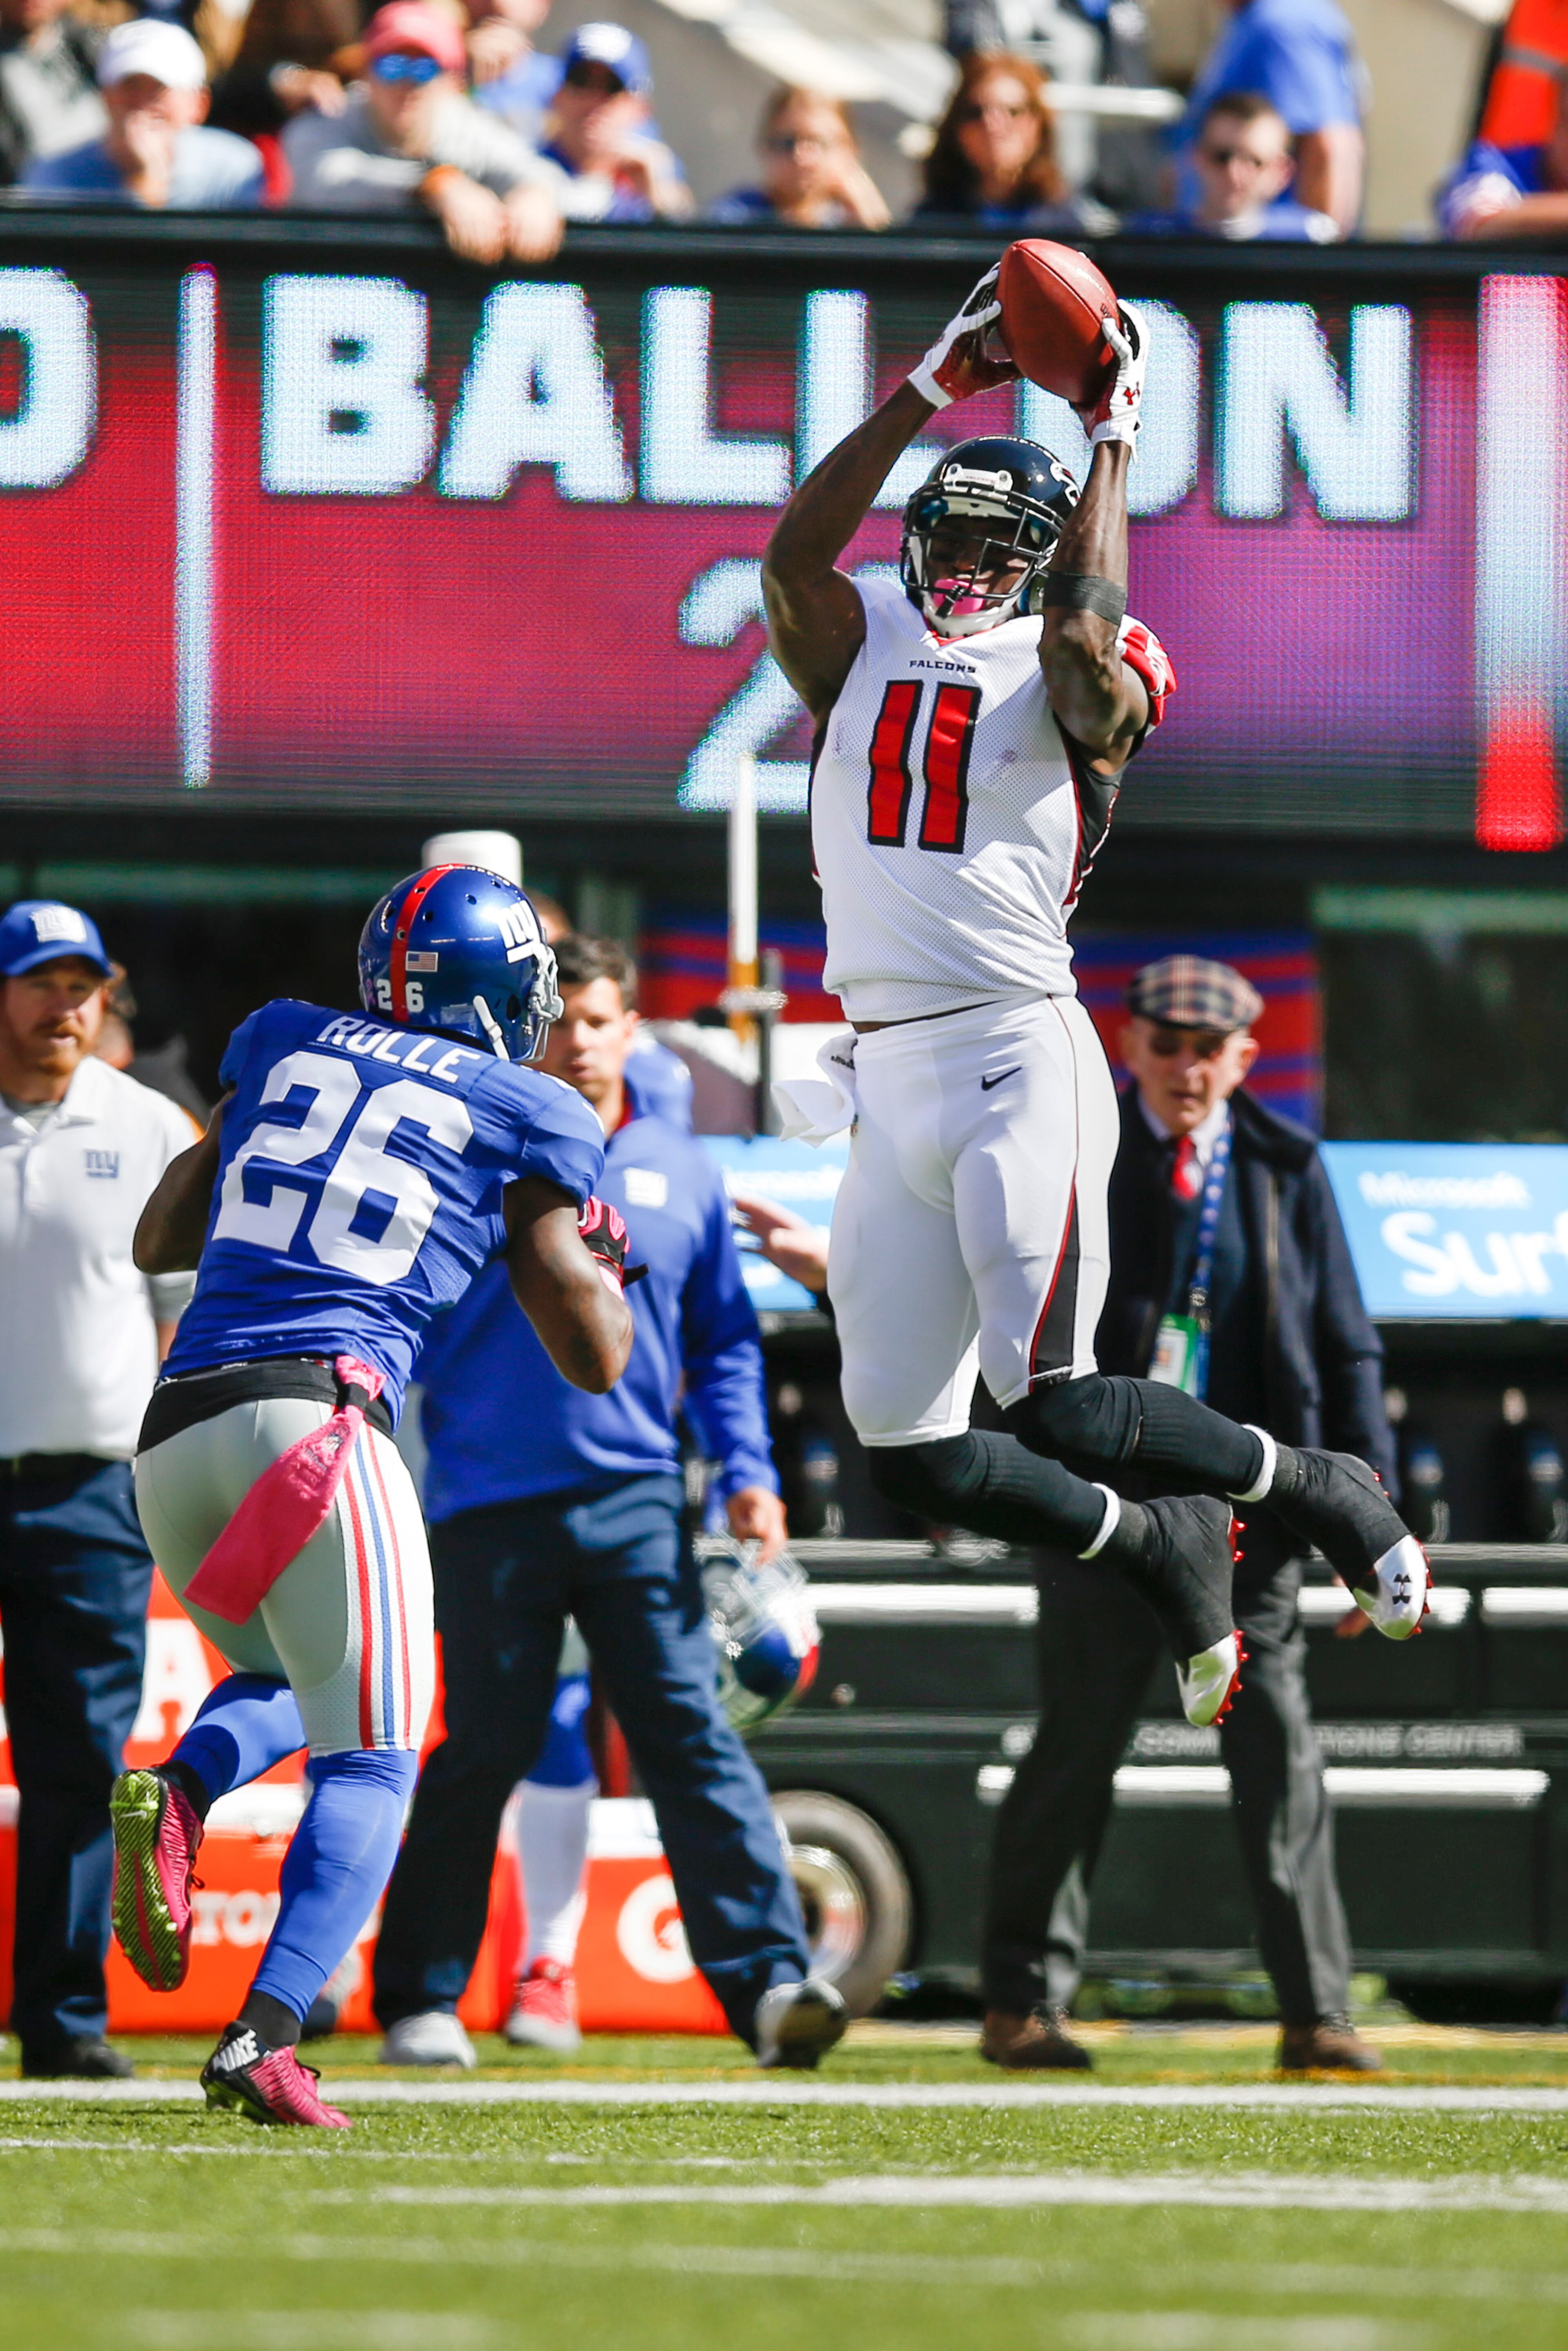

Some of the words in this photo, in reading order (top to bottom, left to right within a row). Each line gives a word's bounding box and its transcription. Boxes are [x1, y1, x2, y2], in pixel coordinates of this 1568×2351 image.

[259, 274, 947, 508] BALL
[1013, 298, 1416, 523] ON
[909, 660, 976, 673] FALCONS
[868, 679, 983, 854] 11
[316, 1015, 481, 1084] ROLLE
[212, 1050, 474, 1286] 26
[212, 2028, 260, 2072] NIKE
